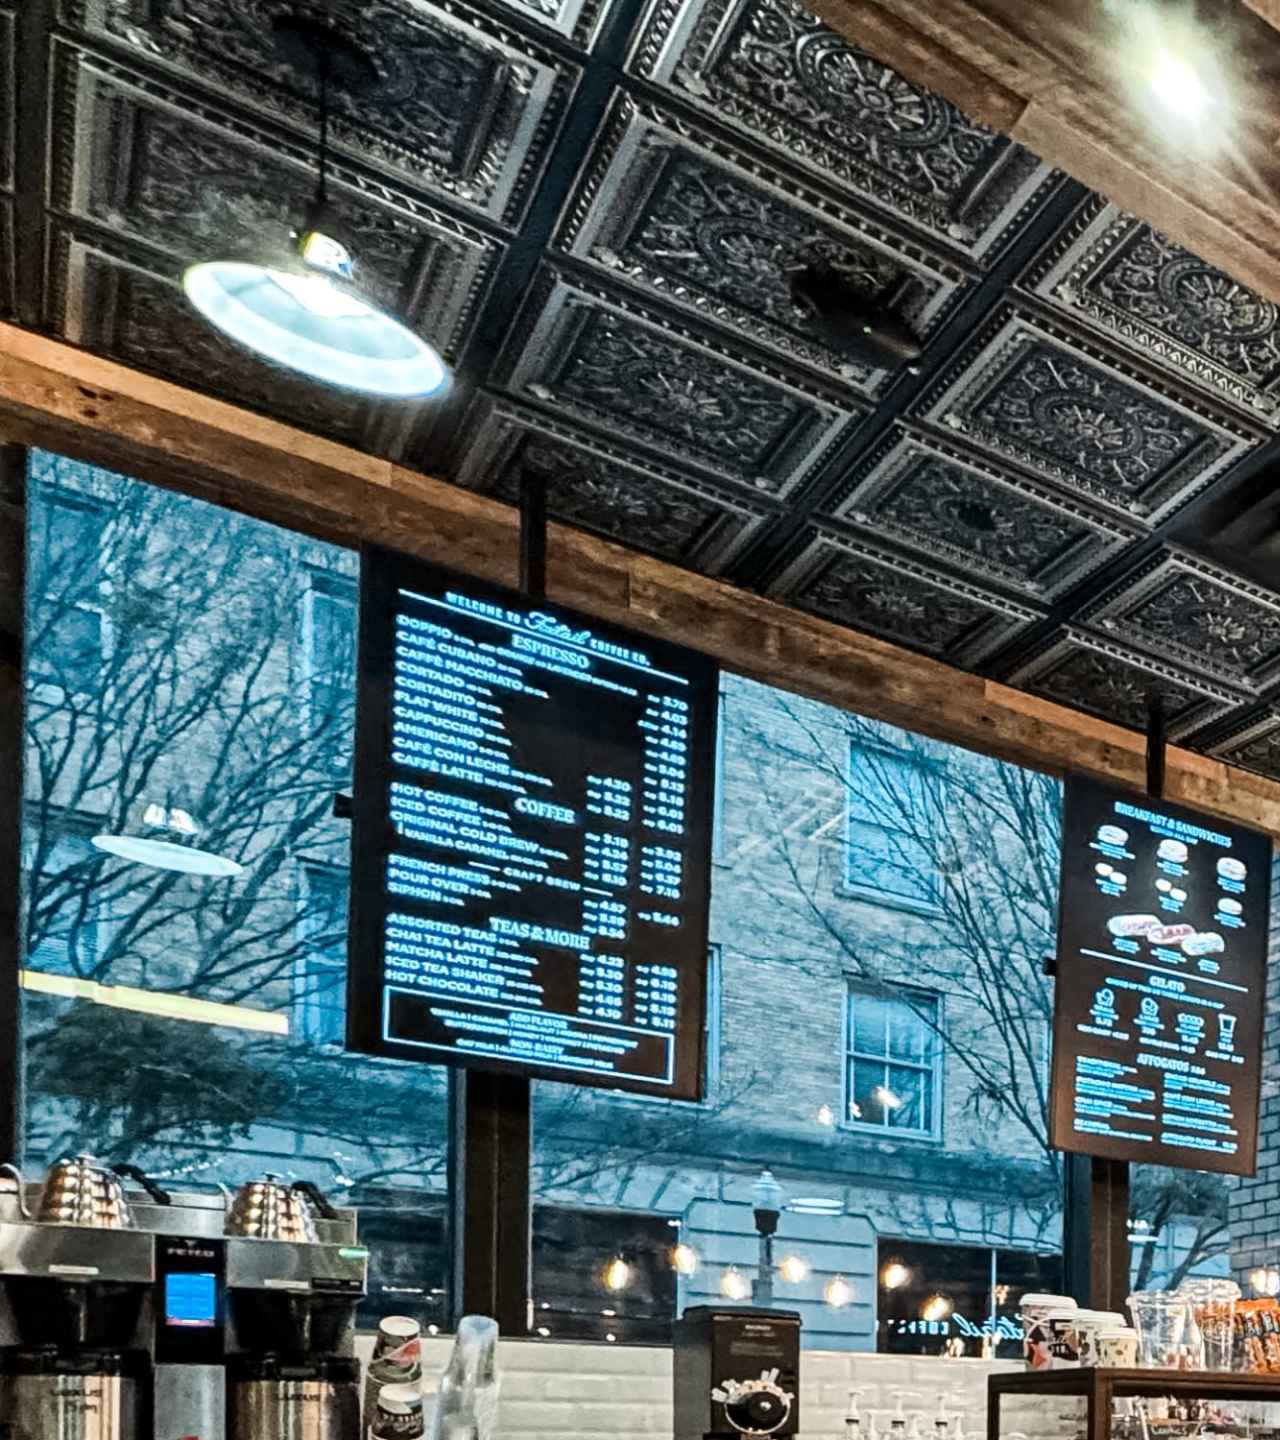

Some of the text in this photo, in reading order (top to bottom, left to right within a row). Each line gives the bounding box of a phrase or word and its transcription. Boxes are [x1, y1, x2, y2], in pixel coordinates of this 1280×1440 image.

[396, 613, 452, 639] DOPPIO
[446, 591, 502, 618] WELCOME
[506, 610, 520, 624] TO
[590, 638, 628, 659] COFFEE
[395, 627, 436, 650] CAFÉ
[437, 641, 496, 668] CUBANO
[511, 633, 590, 670] ESPRESSO
[394, 659, 464, 688] CORTADO
[445, 658, 523, 691] MACCHIATO
[394, 674, 475, 706] CORTADITO
[394, 689, 477, 722] FLAT WHITE
[392, 704, 484, 738] CAPPUCCINO
[393, 719, 478, 752] AMERICANO
[392, 734, 432, 755] CAFÉ
[433, 746, 464, 763] CON
[466, 754, 509, 775] LECHE
[441, 763, 483, 783] LATTE
[390, 780, 423, 798] HOT
[423, 788, 478, 812] COFFEE
[390, 795, 425, 813] ICED
[427, 804, 481, 826] COFFEE
[514, 795, 575, 825] COFFEE
[389, 808, 458, 834] ORIGINAL
[459, 825, 497, 843] COLD
[498, 834, 539, 853] BREW
[1113, 800, 1167, 827] BREAKFAST
[1175, 819, 1232, 848] SANDWICHES
[404, 827, 509, 860] VANILLA CARAMEL
[388, 852, 490, 885] FRENCH PRESS
[388, 867, 469, 894] POUR OVER
[503, 866, 580, 891] CRAFT BREW
[387, 881, 441, 902] SIPHON
[385, 926, 422, 942] CHAI
[423, 933, 451, 948] TEA
[453, 938, 494, 956] LATTE
[386, 911, 461, 935] ASSORTED
[462, 926, 497, 943] TEAS
[384, 954, 419, 970] ICED
[422, 961, 449, 975] TEA
[451, 966, 505, 985] SHAKER
[385, 940, 443, 960] MATCHA
[446, 951, 487, 968] LATTE
[384, 968, 498, 998] HOT CHOCOLATE
[1148, 974, 1186, 993] GELATO
